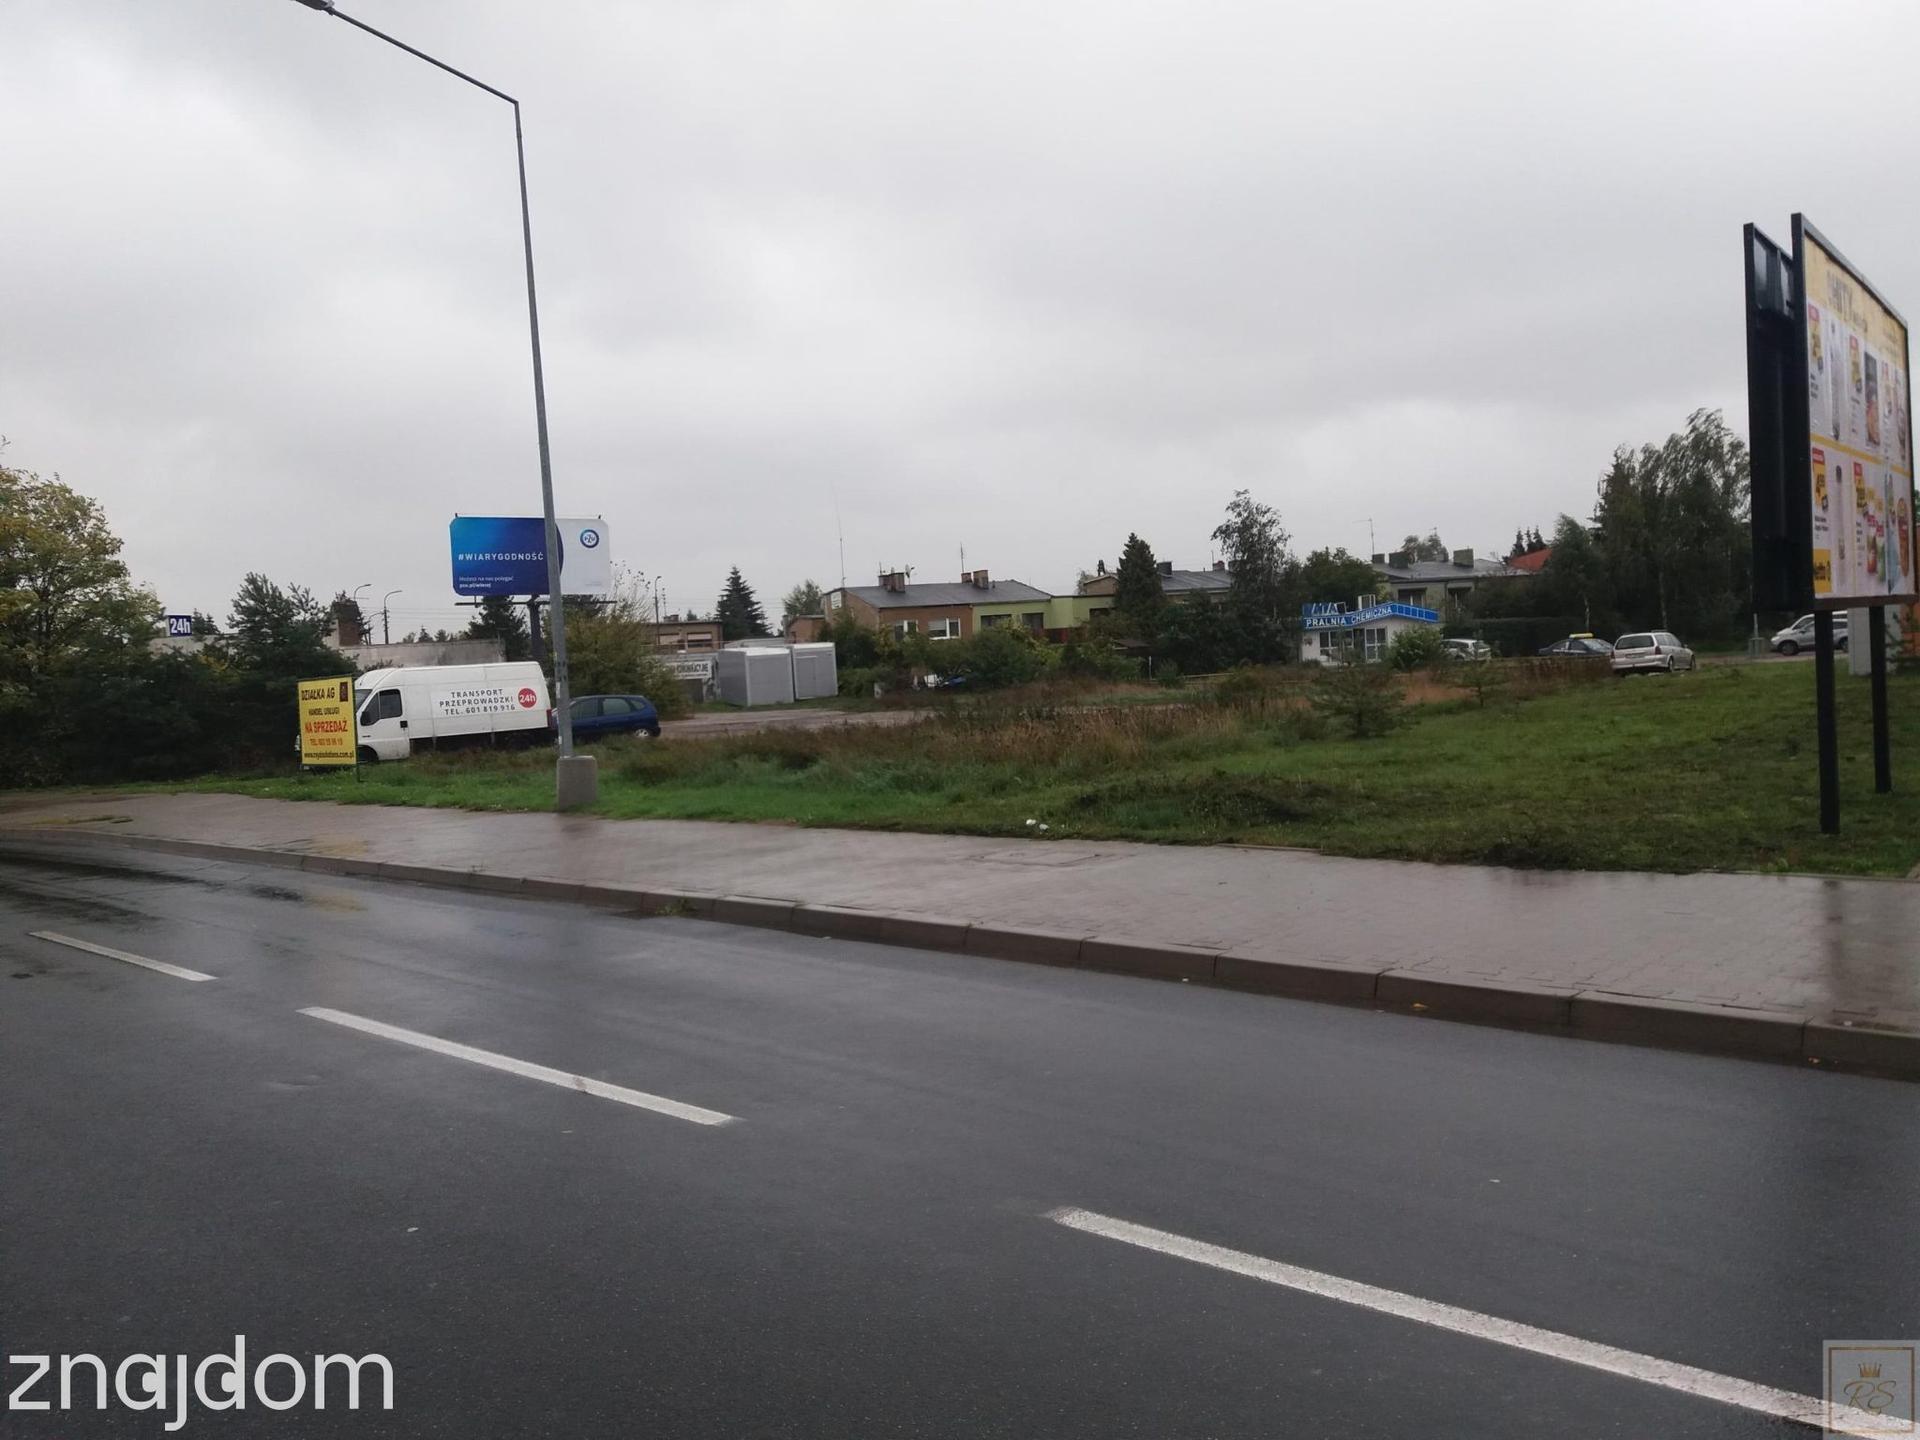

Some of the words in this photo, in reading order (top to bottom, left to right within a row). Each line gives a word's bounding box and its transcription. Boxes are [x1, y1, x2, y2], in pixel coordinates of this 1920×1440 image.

[458, 552, 544, 561] #WIARYGODNOŚĆ
[1306, 617, 1347, 628] PRALNIA
[1351, 606, 1392, 624] CHEMICZNA
[170, 618, 191, 634] 24h
[301, 689, 325, 701] DZIAŁKA
[326, 687, 335, 699] AG
[451, 689, 503, 698] TRANSPORT
[519, 693, 536, 703] 24h
[440, 696, 514, 707] PRZEPROWADZKI
[305, 722, 313, 733] NA
[314, 717, 348, 733] SPRZEDAŻ
